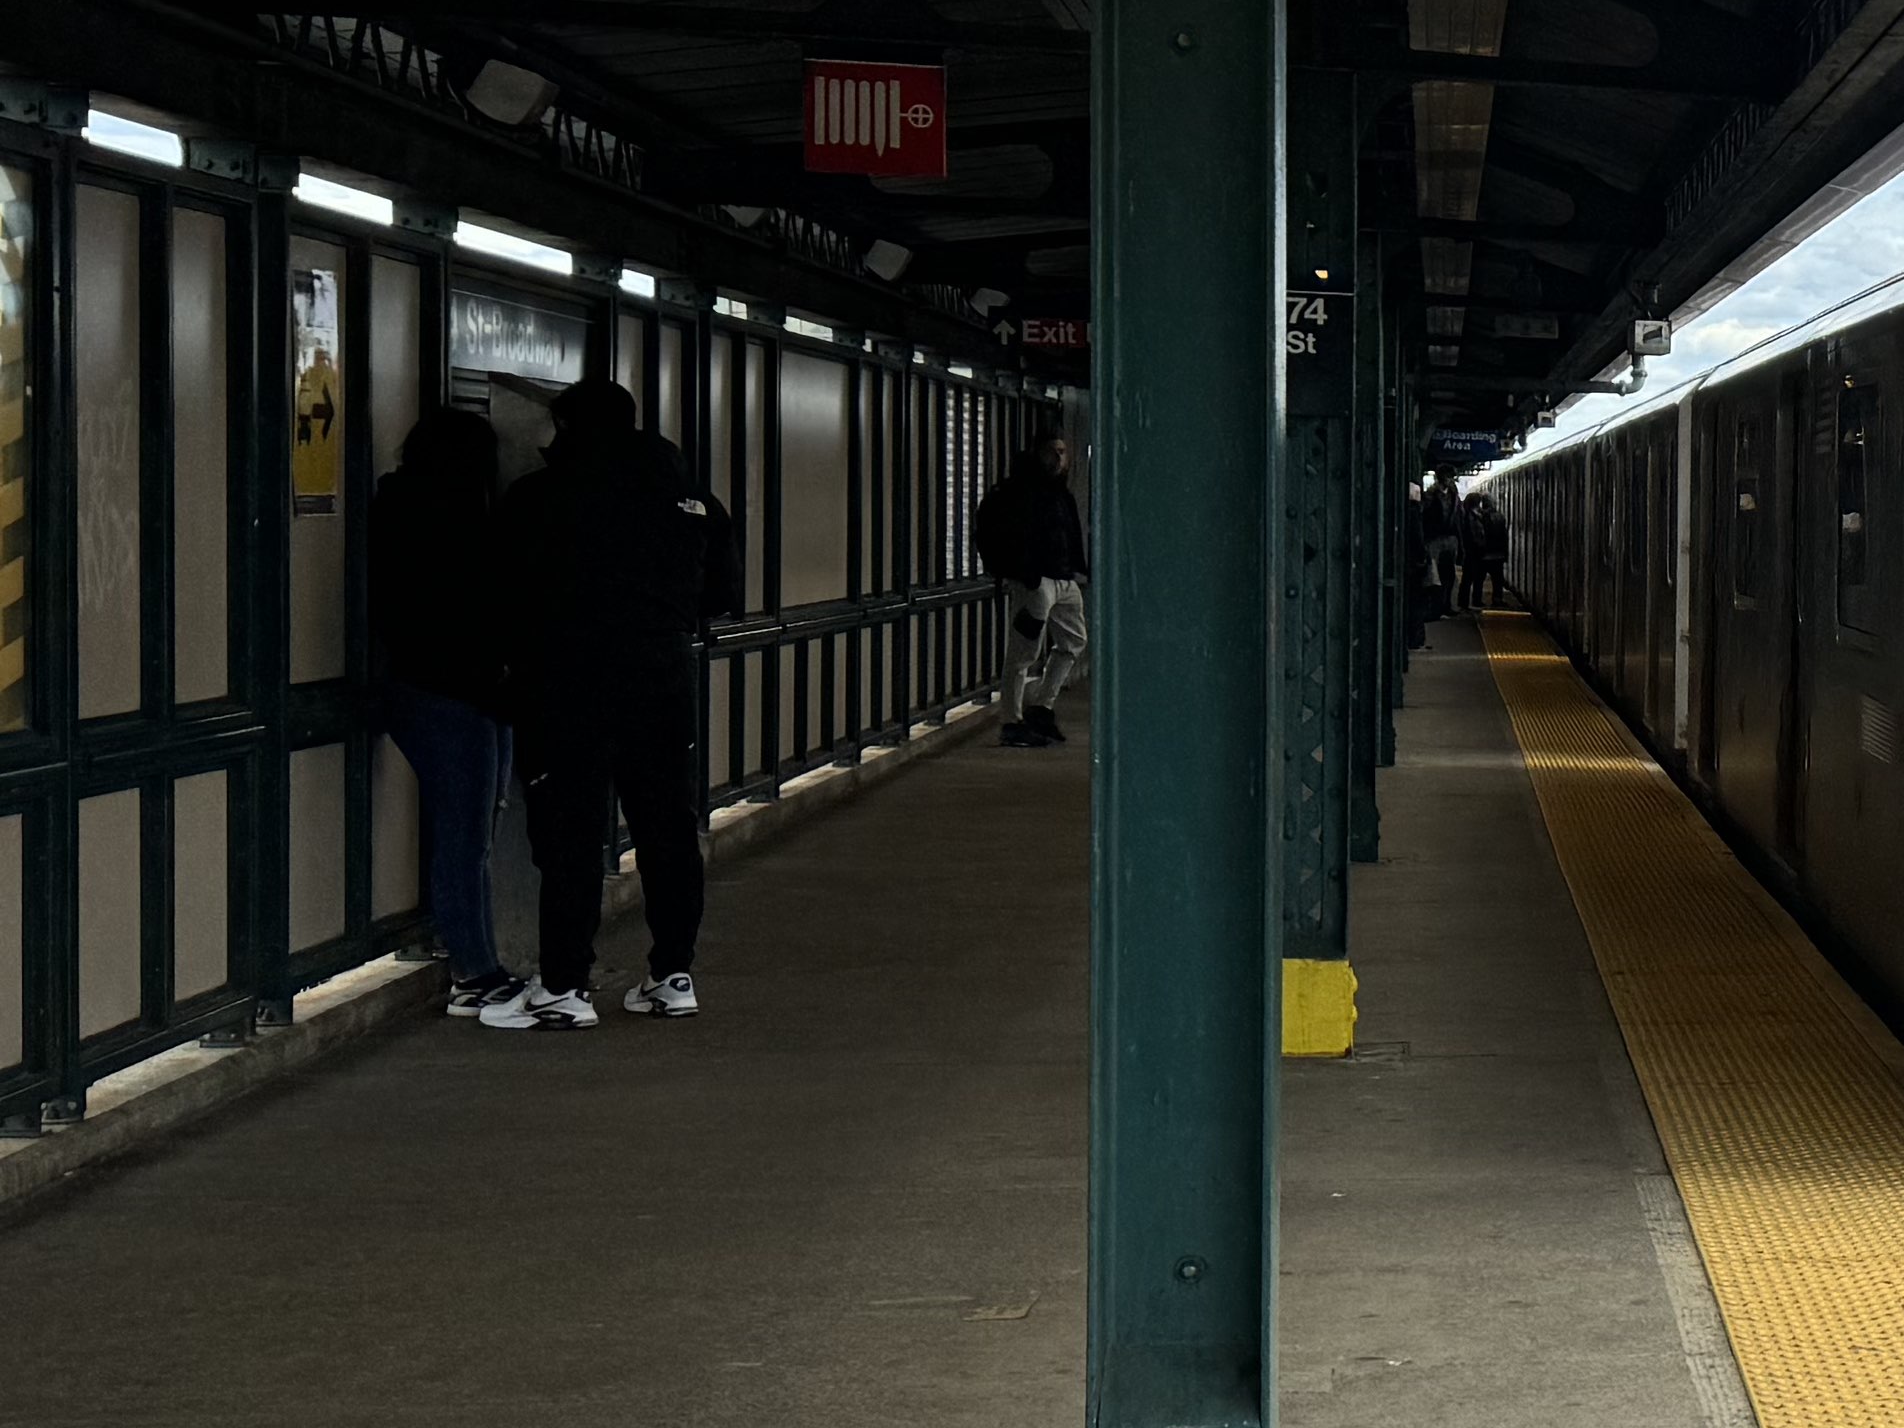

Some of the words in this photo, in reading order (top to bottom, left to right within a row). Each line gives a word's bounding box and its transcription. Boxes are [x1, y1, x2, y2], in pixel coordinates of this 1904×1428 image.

[1286, 296, 1328, 326] 74
[1022, 319, 1077, 344] Exit
[1286, 330, 1317, 354] St
[1442, 439, 1472, 451] Area
